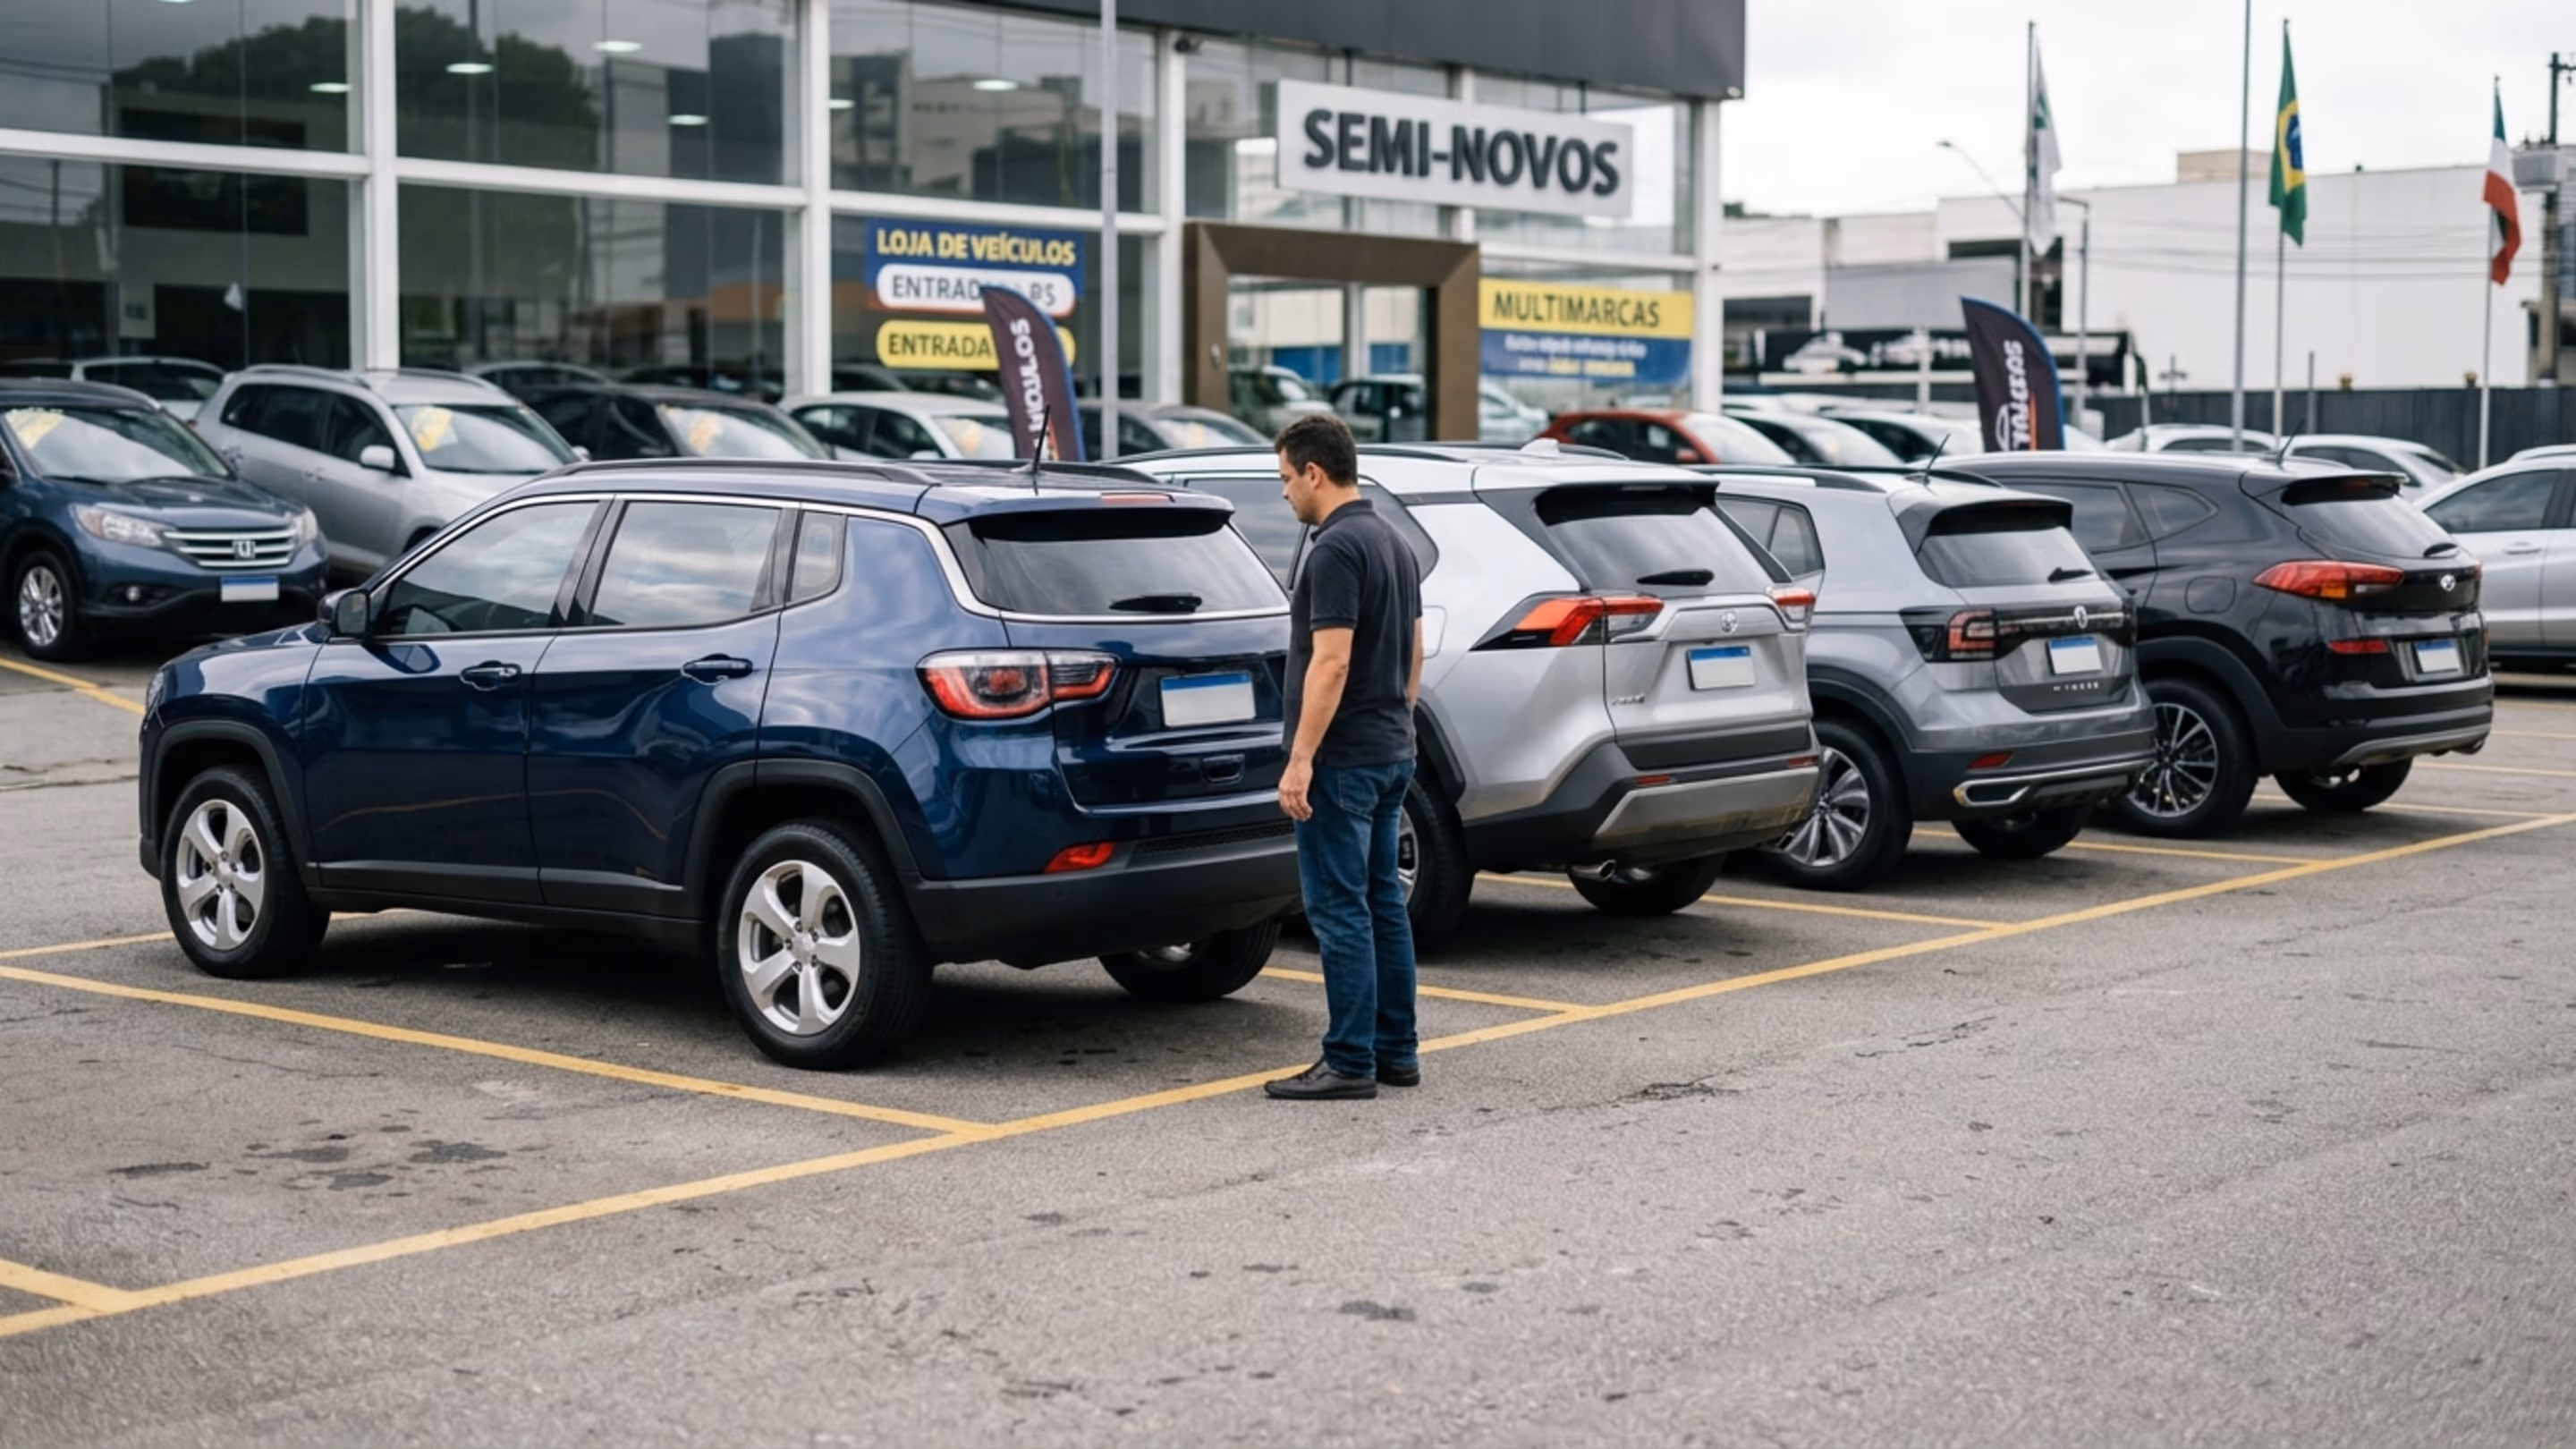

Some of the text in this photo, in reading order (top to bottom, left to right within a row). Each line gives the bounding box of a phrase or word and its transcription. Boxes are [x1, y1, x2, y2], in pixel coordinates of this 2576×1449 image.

[1304, 109, 1619, 195] SEMI-NOVOS
[877, 229, 1075, 265] LOJA DE VEÍCULOS
[892, 275, 984, 301] ENTRAD
[1494, 292, 1660, 328] MULTIMARCAS
[888, 334, 992, 359] ENTRADA
